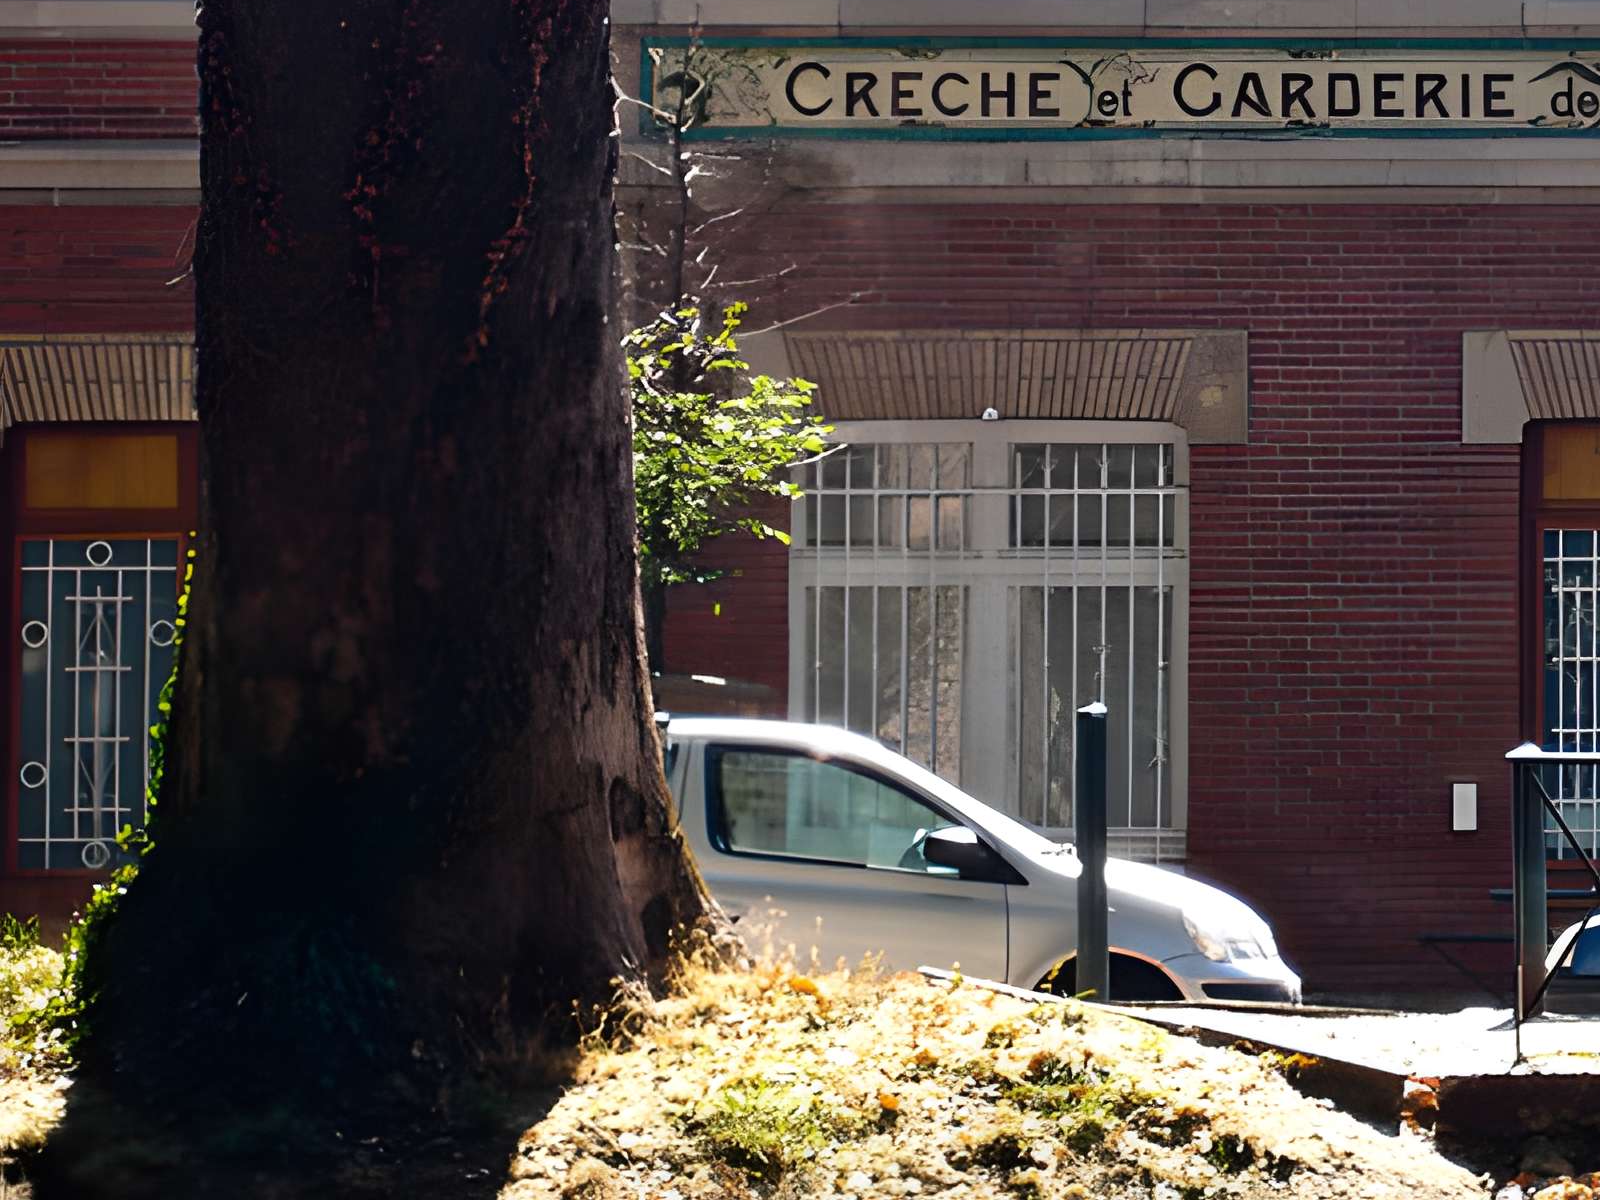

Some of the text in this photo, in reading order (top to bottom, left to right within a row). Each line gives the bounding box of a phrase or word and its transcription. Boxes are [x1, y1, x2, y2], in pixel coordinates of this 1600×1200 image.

[785, 61, 1061, 118] CRECHE
[1096, 78, 1133, 117] et
[1173, 62, 1515, 119] GARDERIE
